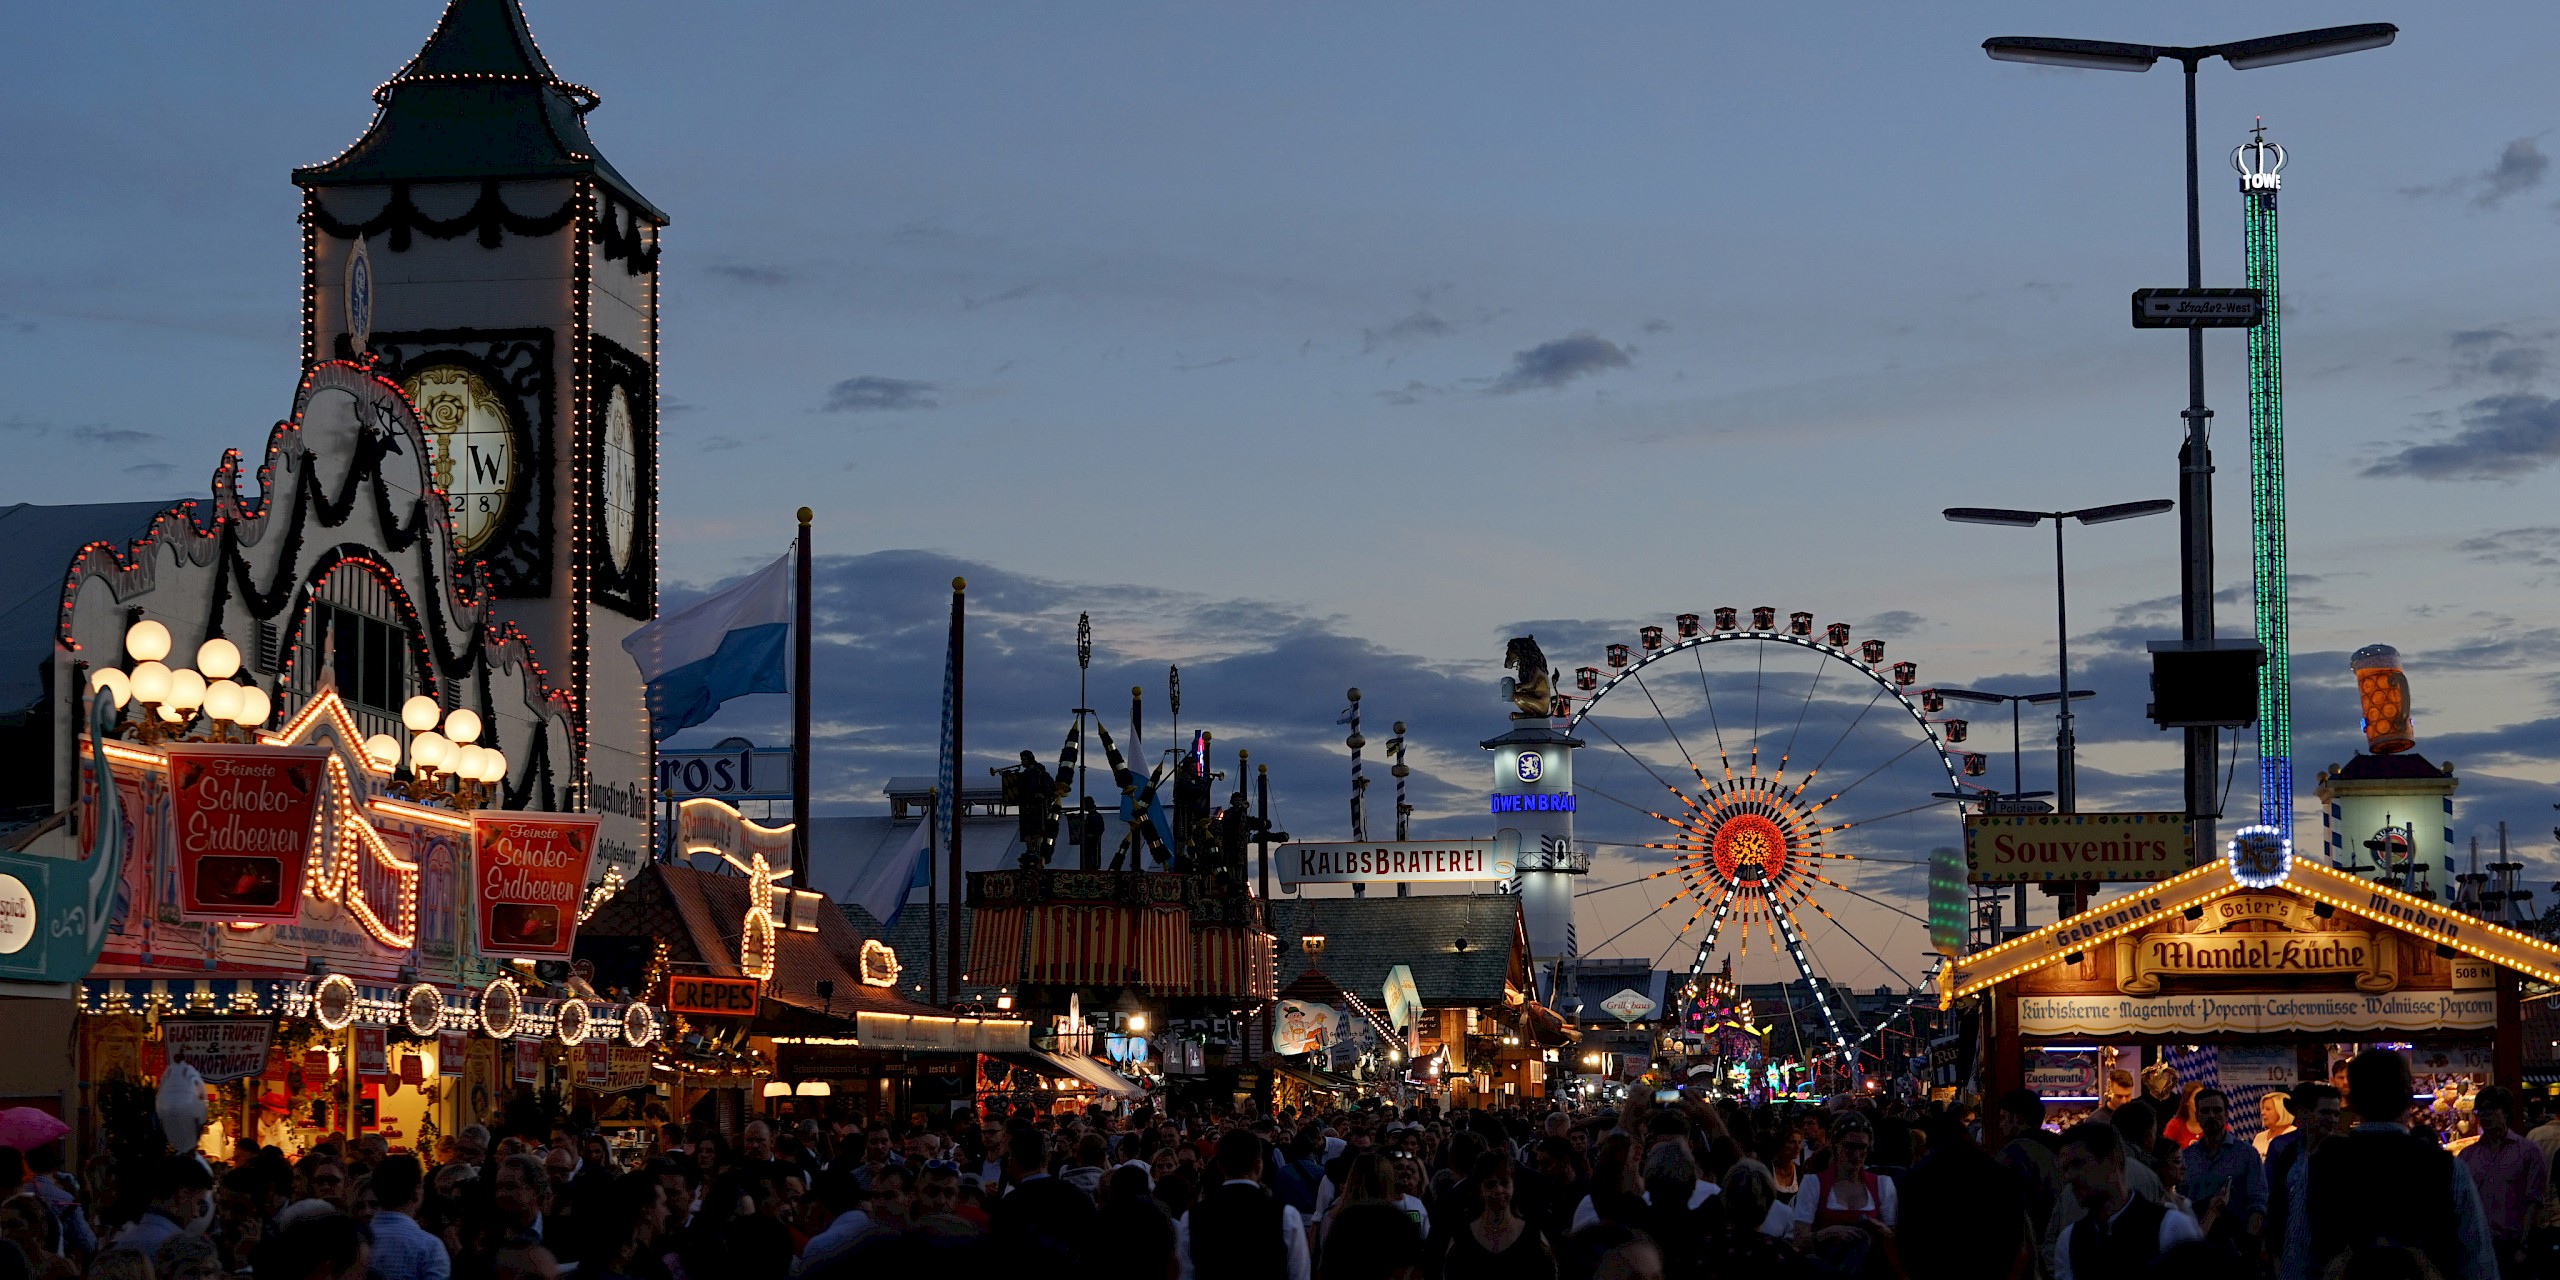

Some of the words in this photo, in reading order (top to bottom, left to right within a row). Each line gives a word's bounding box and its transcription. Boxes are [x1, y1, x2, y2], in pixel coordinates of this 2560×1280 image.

[212, 759, 276, 777] Feinste
[197, 776, 298, 812] Schoko-
[1490, 791, 1576, 814] LÖWENBRÄU
[2000, 803, 2037, 814] Polizei
[185, 810, 299, 853] Erdbeeren
[508, 823, 559, 839] Feinste
[495, 837, 575, 868] Schoko-
[1994, 832, 2167, 864] Souvenirs
[484, 865, 574, 901] Erdbeeren
[2220, 897, 2289, 919] Geier's
[2369, 893, 2458, 938] Mandeln
[2055, 898, 2161, 947] Gebrannte
[2152, 939, 2364, 969] Mandel-Küche
[2455, 968, 2478, 979] 508
[2481, 968, 2491, 978] N
[672, 980, 755, 1009] CRÊPES
[2022, 999, 2110, 1020] Kürbiskerne
[2120, 998, 2196, 1020] Magenbrot
[2203, 998, 2262, 1022] Popcorn
[2267, 998, 2357, 1018] Cashewnüsse
[2366, 997, 2435, 1014] Walnüsse
[2440, 997, 2493, 1019] Popcorn
[170, 1024, 221, 1042] GLASIERTE
[221, 1022, 267, 1042] FRÜCHTE
[206, 1043, 221, 1053] &
[2026, 1073, 2084, 1084] Zuckerwatte
